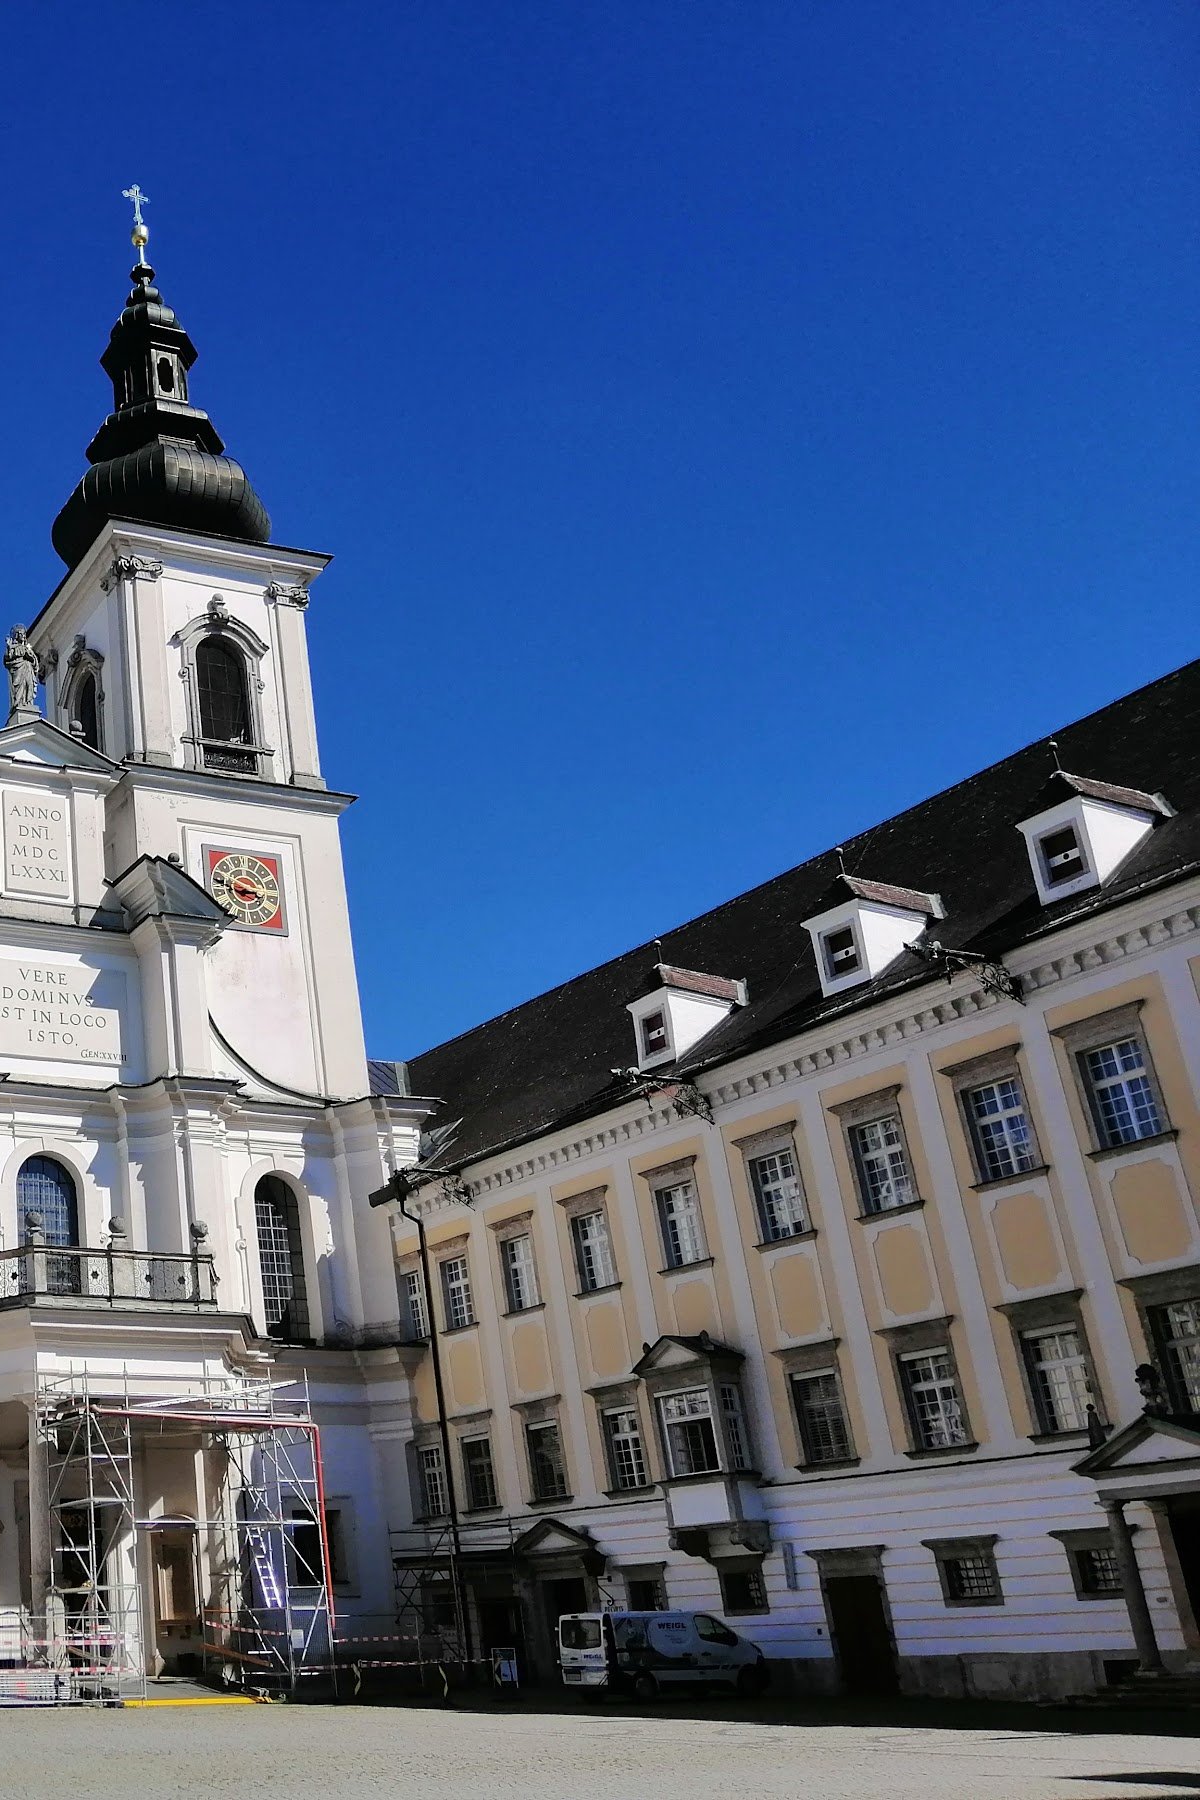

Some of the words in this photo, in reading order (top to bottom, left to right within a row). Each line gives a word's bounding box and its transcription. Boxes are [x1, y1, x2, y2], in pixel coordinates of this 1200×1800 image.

[9, 805, 62, 822] ANNO
[19, 968, 68, 986] VERE
[2, 986, 94, 1008] DOMINVS
[32, 1009, 52, 1024] IN
[59, 1012, 107, 1029] LOCO
[28, 1029, 78, 1047] ISTO.
[657, 1622, 687, 1630] WEIGL
